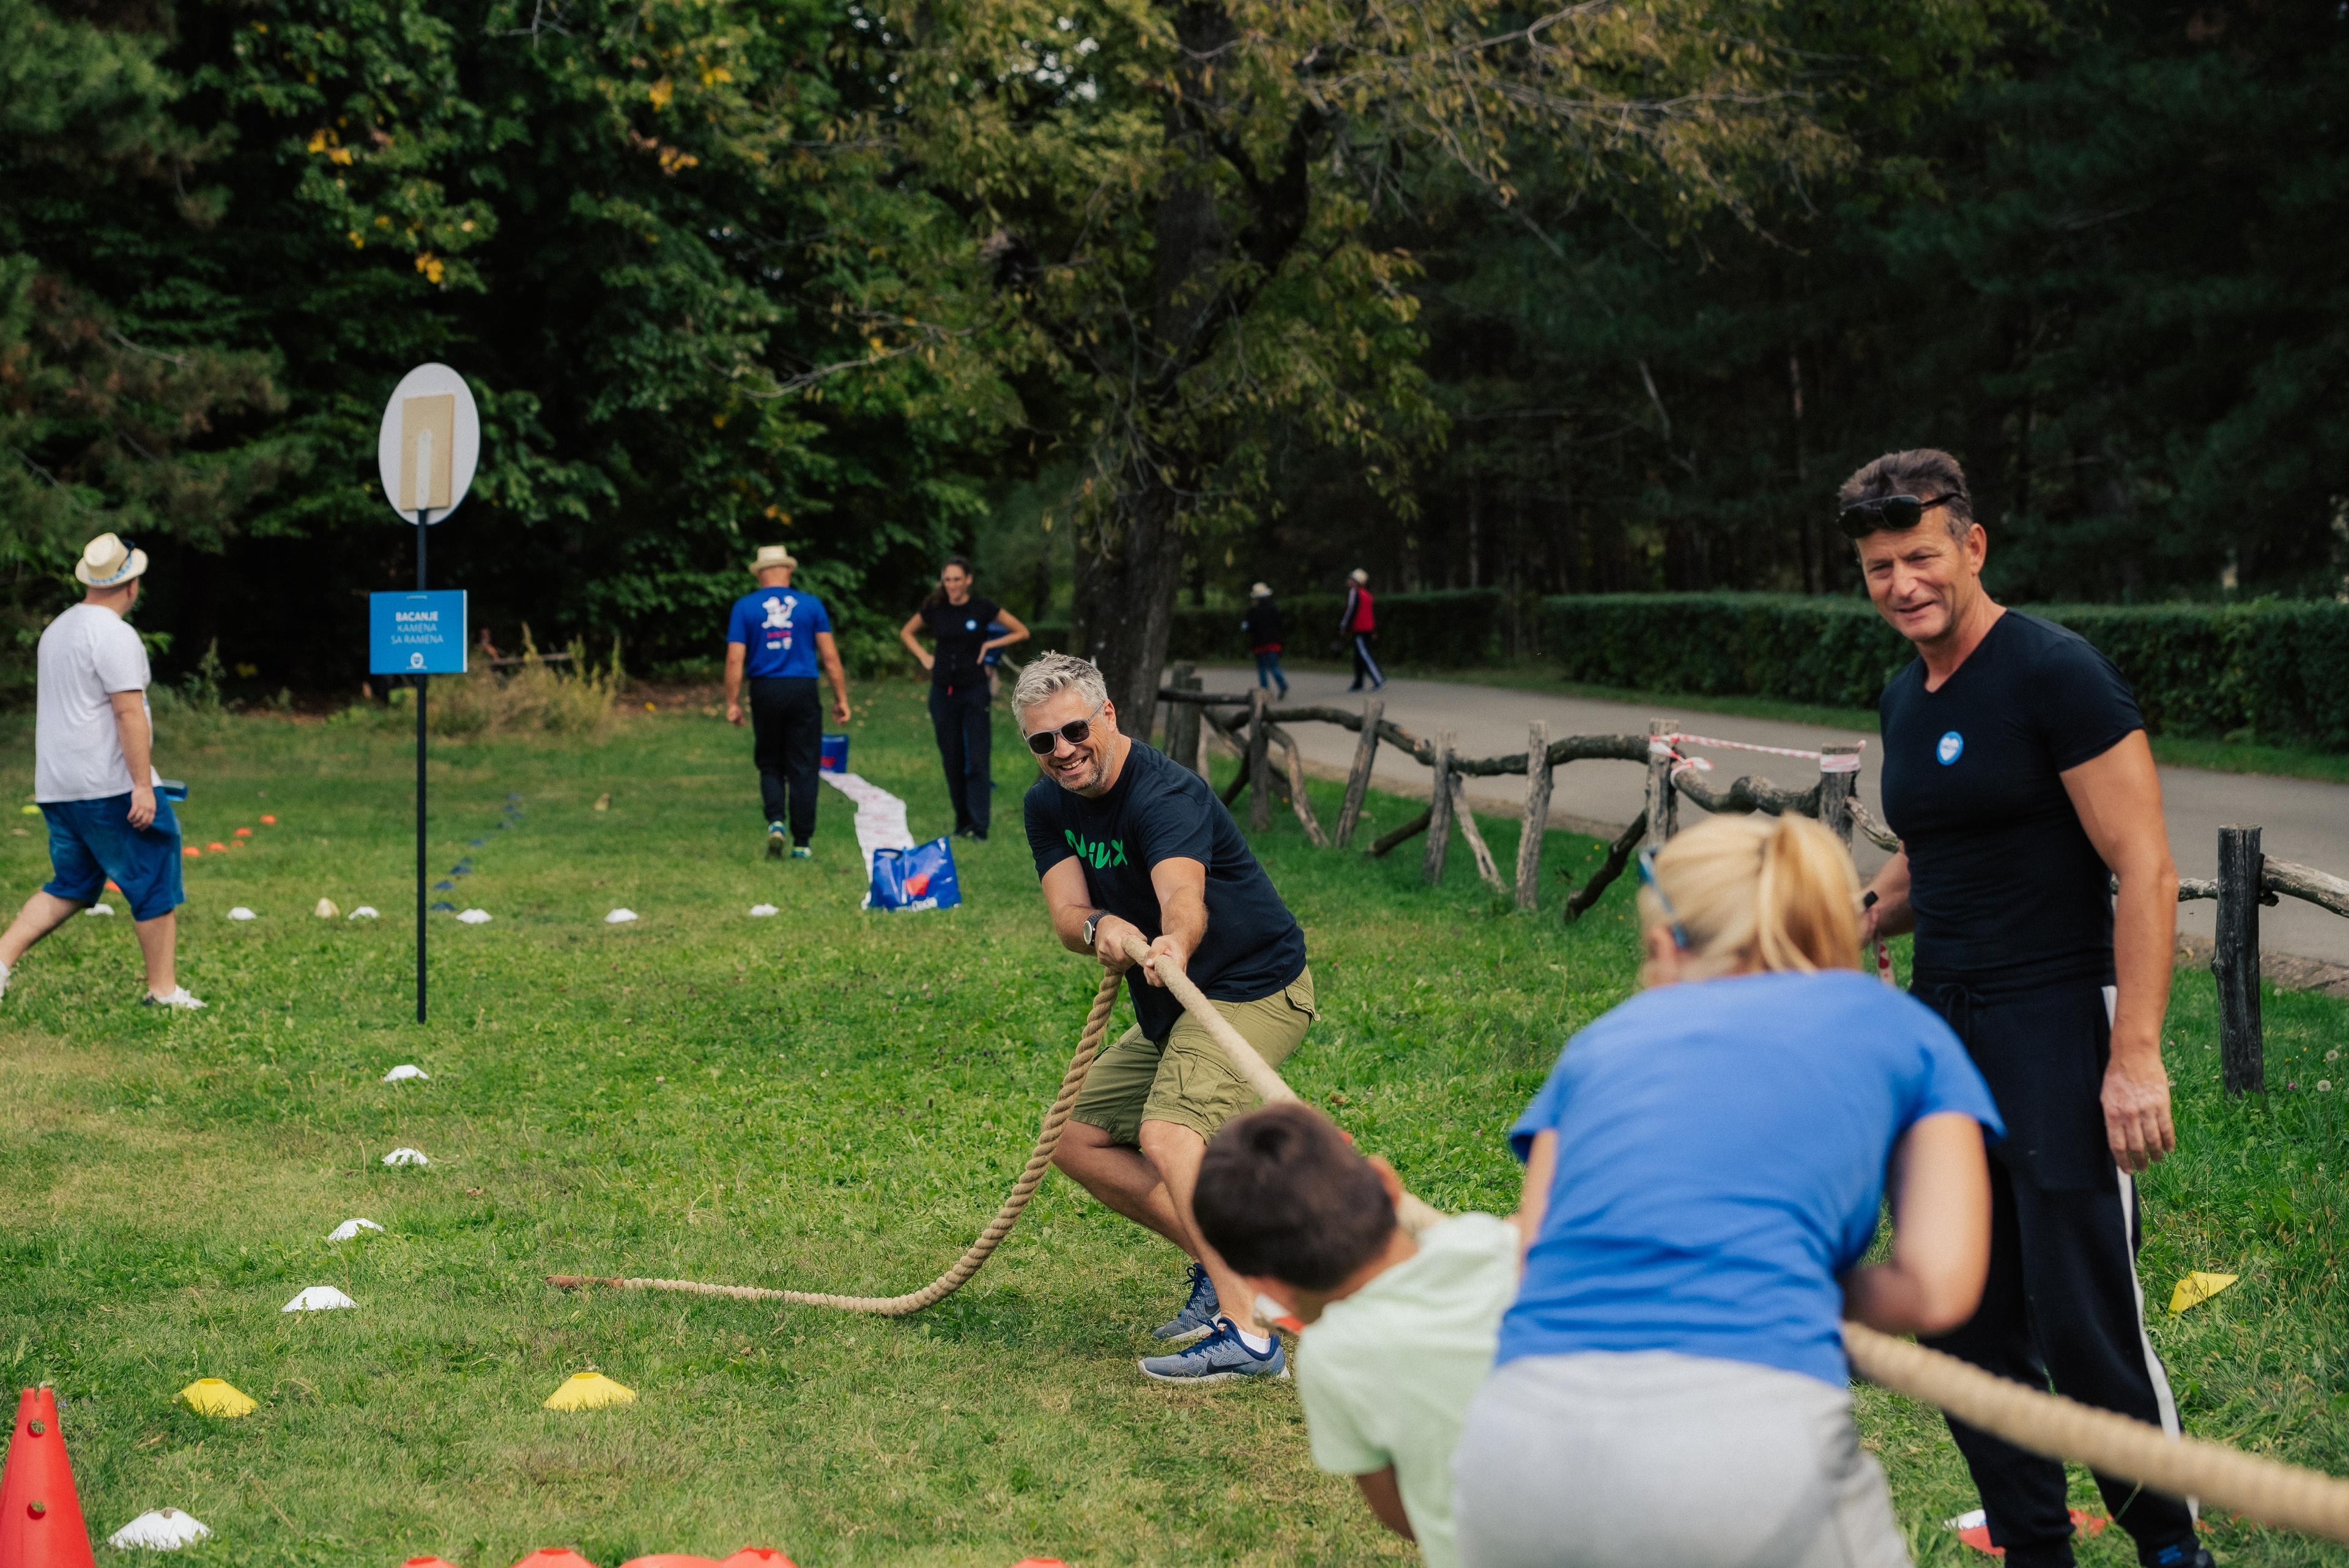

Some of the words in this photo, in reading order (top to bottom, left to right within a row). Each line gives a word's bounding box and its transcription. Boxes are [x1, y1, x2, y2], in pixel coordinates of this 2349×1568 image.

[396, 611, 439, 622] BACANJE
[398, 623, 437, 633] KAMENA
[391, 634, 403, 644] SA
[404, 634, 443, 644] RAMENA
